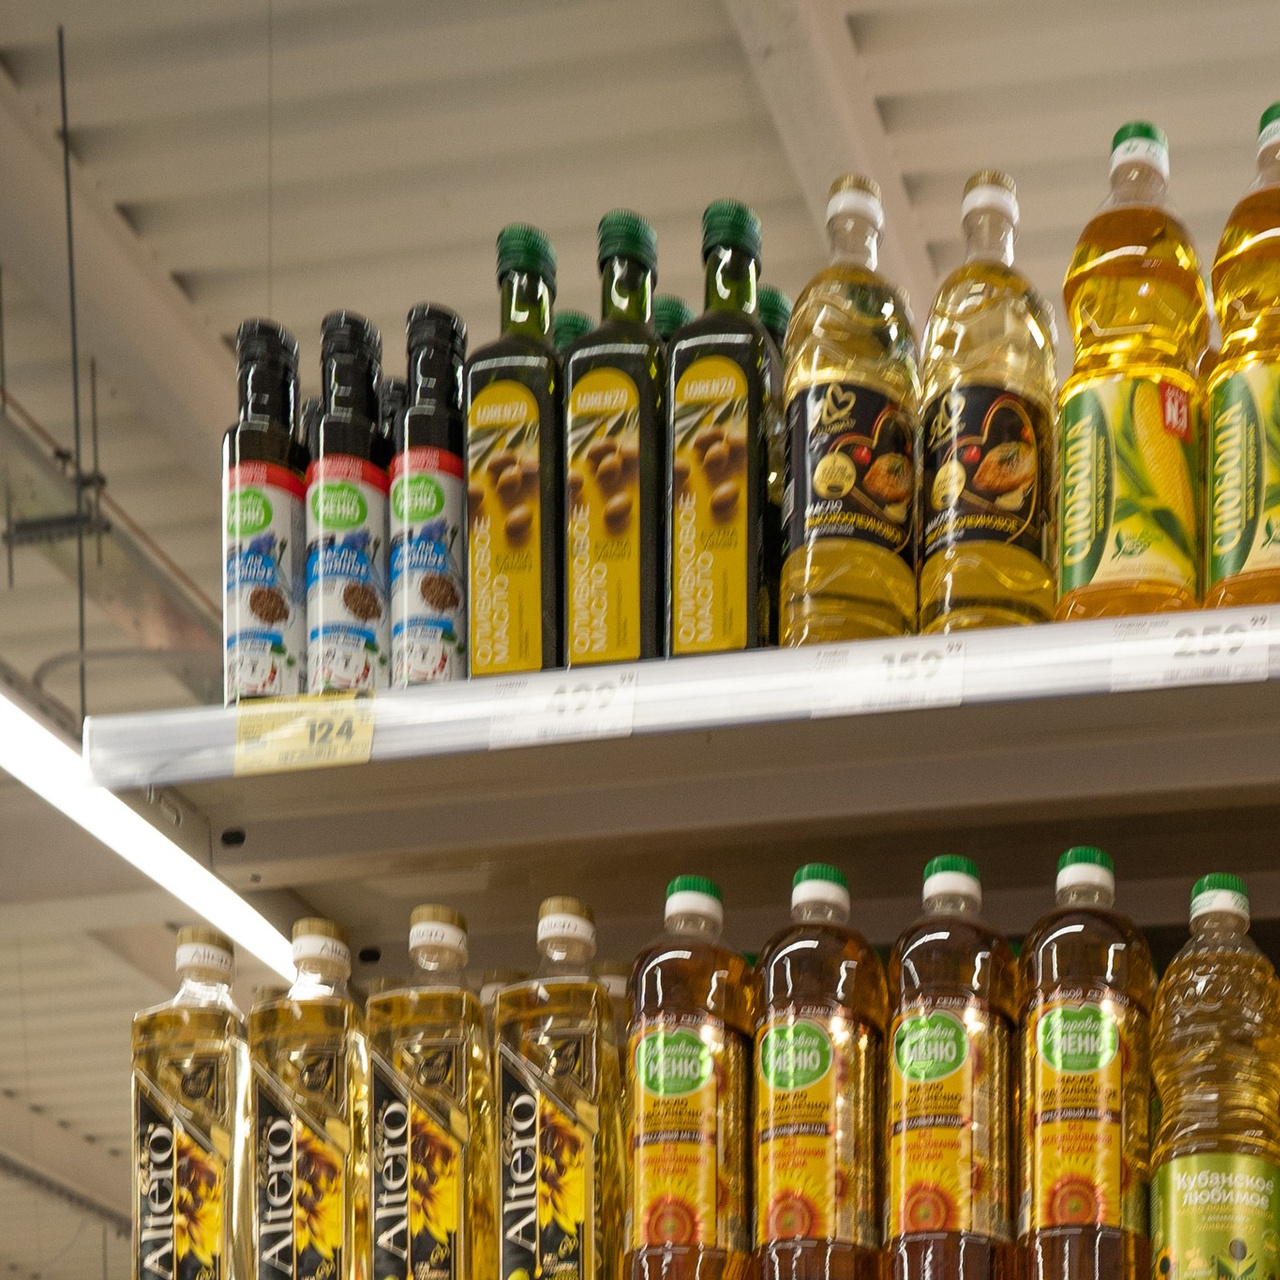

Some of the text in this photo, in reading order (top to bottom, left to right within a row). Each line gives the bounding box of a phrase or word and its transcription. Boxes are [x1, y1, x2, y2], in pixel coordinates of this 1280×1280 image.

[306, 717, 356, 746] 124
[260, 1119, 294, 1278] Altero
[376, 1101, 409, 1260] Altero
[503, 1094, 538, 1256] Altero
